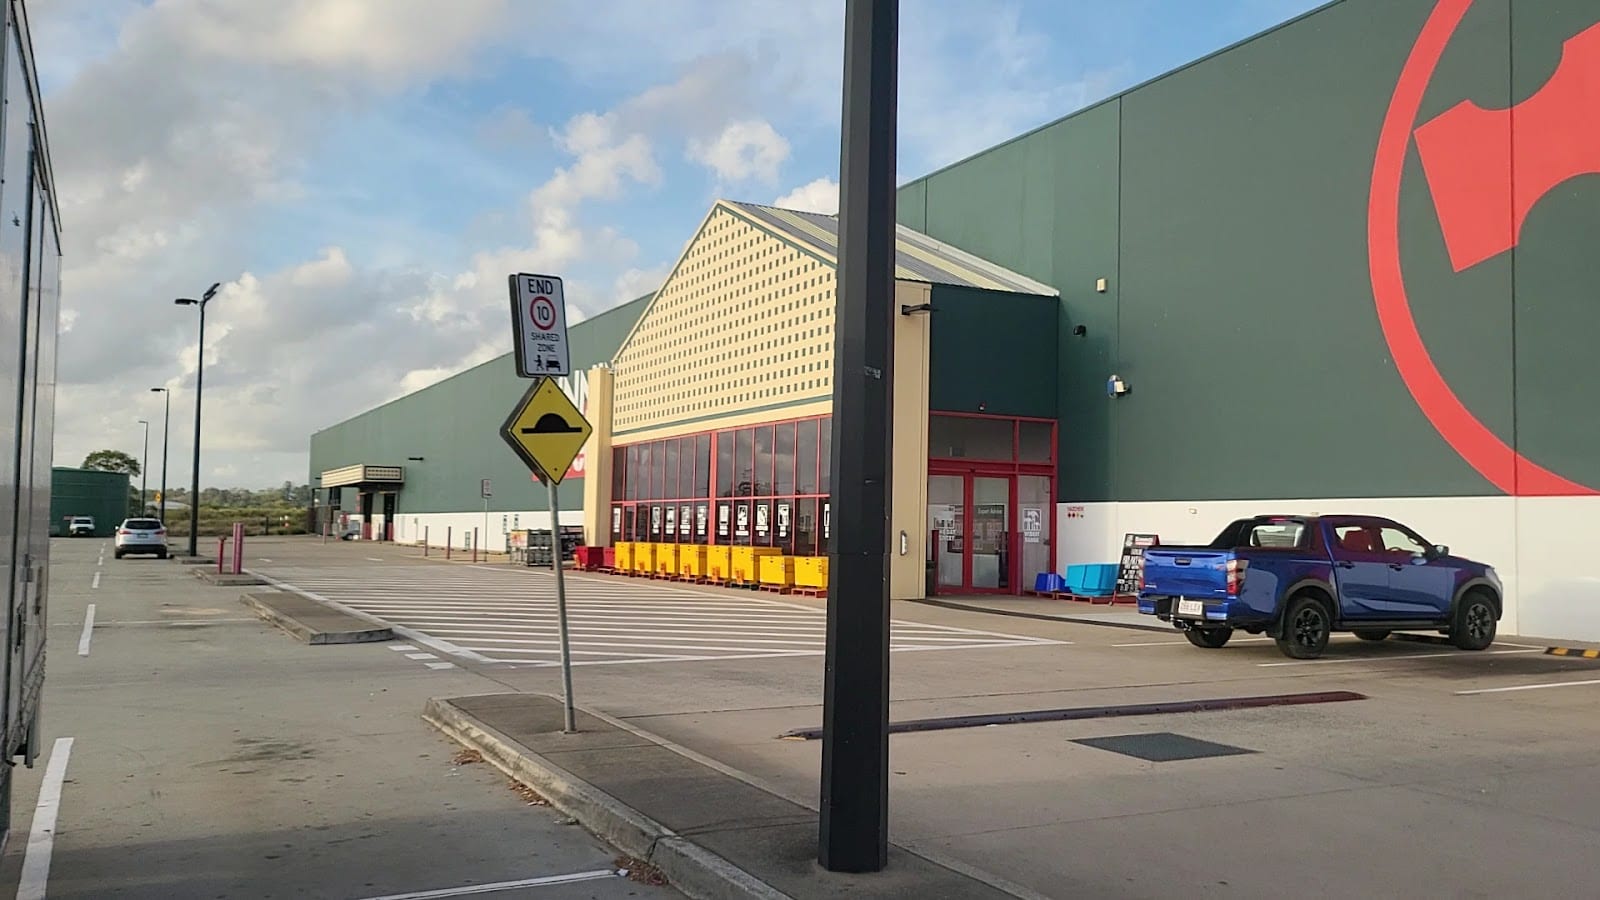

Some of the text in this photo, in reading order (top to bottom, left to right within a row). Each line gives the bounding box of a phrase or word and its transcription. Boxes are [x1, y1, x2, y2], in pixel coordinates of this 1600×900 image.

[528, 278, 553, 295] END
[537, 305, 550, 321] 10
[530, 332, 560, 342] SHARED
[537, 343, 556, 353] ZONE
